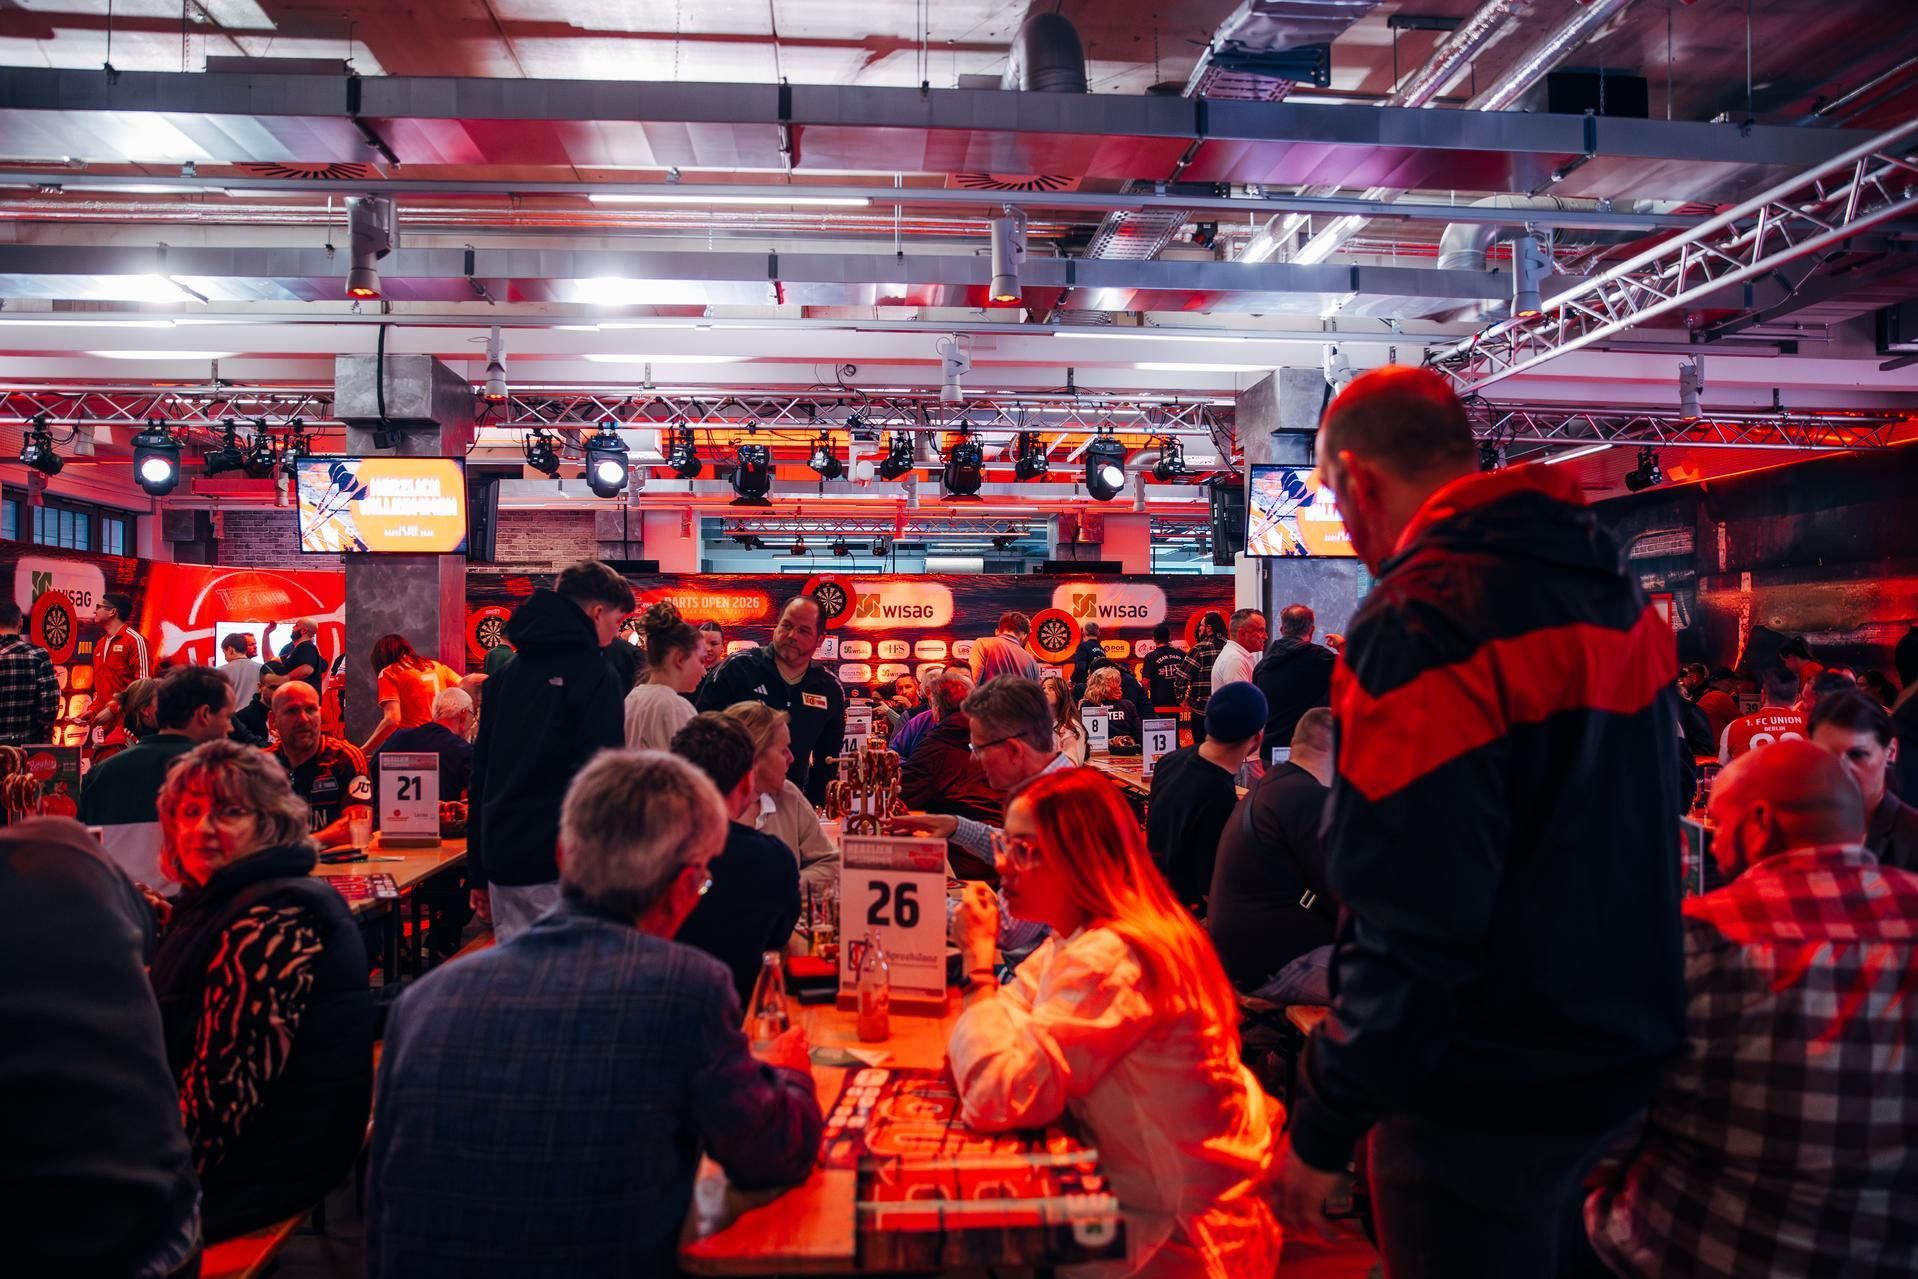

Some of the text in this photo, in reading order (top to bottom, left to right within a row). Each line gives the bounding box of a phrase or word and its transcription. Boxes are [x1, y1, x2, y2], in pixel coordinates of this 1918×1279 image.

[701, 596, 730, 608] OPEN
[732, 597, 760, 608] 2026
[826, 640, 833, 652] 3
[1745, 703, 1758, 714] 39
[1107, 711, 1125, 720] TER
[1755, 717, 1768, 725] FC
[1770, 716, 1802, 725] UNION
[1091, 719, 1099, 732] 8
[841, 738, 858, 753] 14
[1152, 734, 1167, 751] 13
[397, 775, 421, 801] 21
[867, 880, 920, 929] 26
